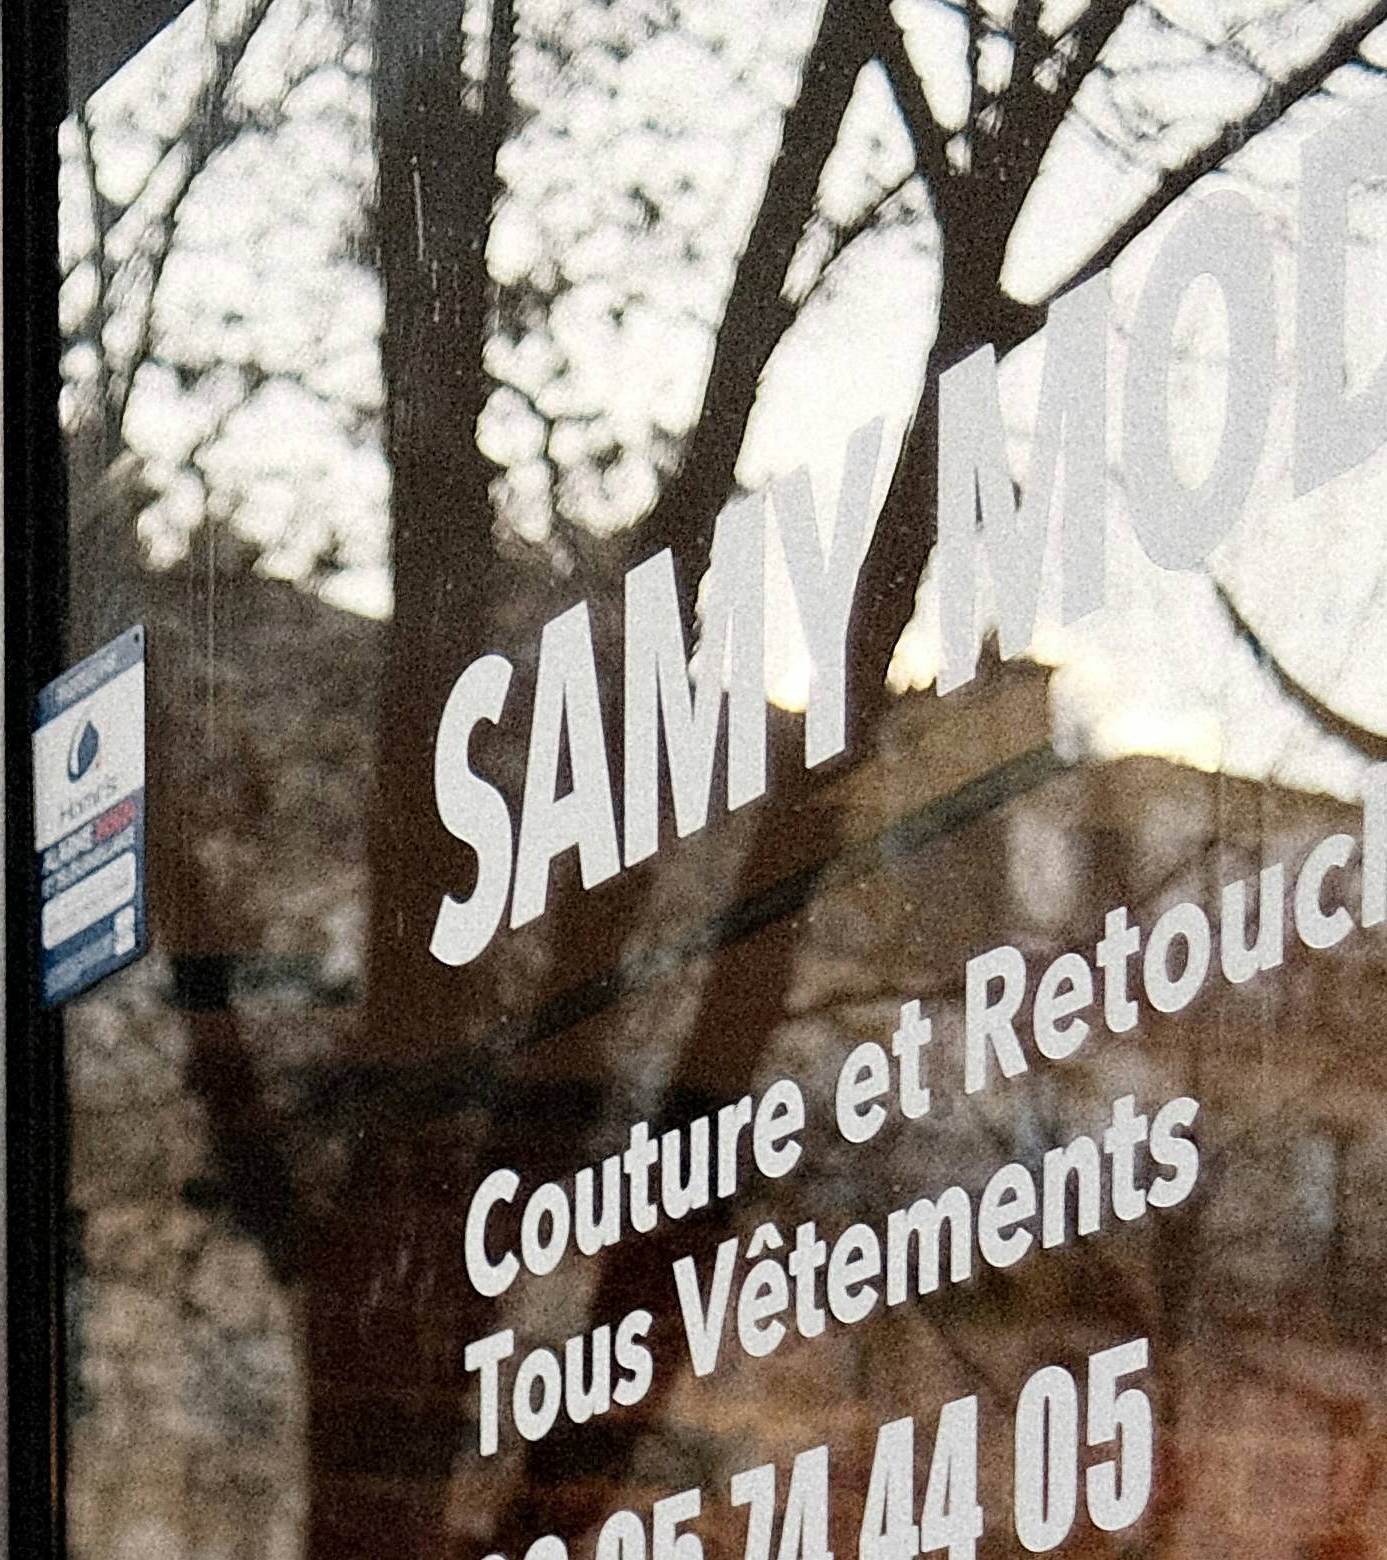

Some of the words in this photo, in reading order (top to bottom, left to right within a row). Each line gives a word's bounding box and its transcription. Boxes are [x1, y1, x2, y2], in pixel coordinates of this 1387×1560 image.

[430, 416, 883, 965] SAMY
[464, 1079, 805, 1298] Couture
[836, 998, 931, 1144] et
[464, 1309, 652, 1457] Tous
[673, 1094, 1200, 1378] Vêtements
[1014, 1337, 1154, 1553] 05
